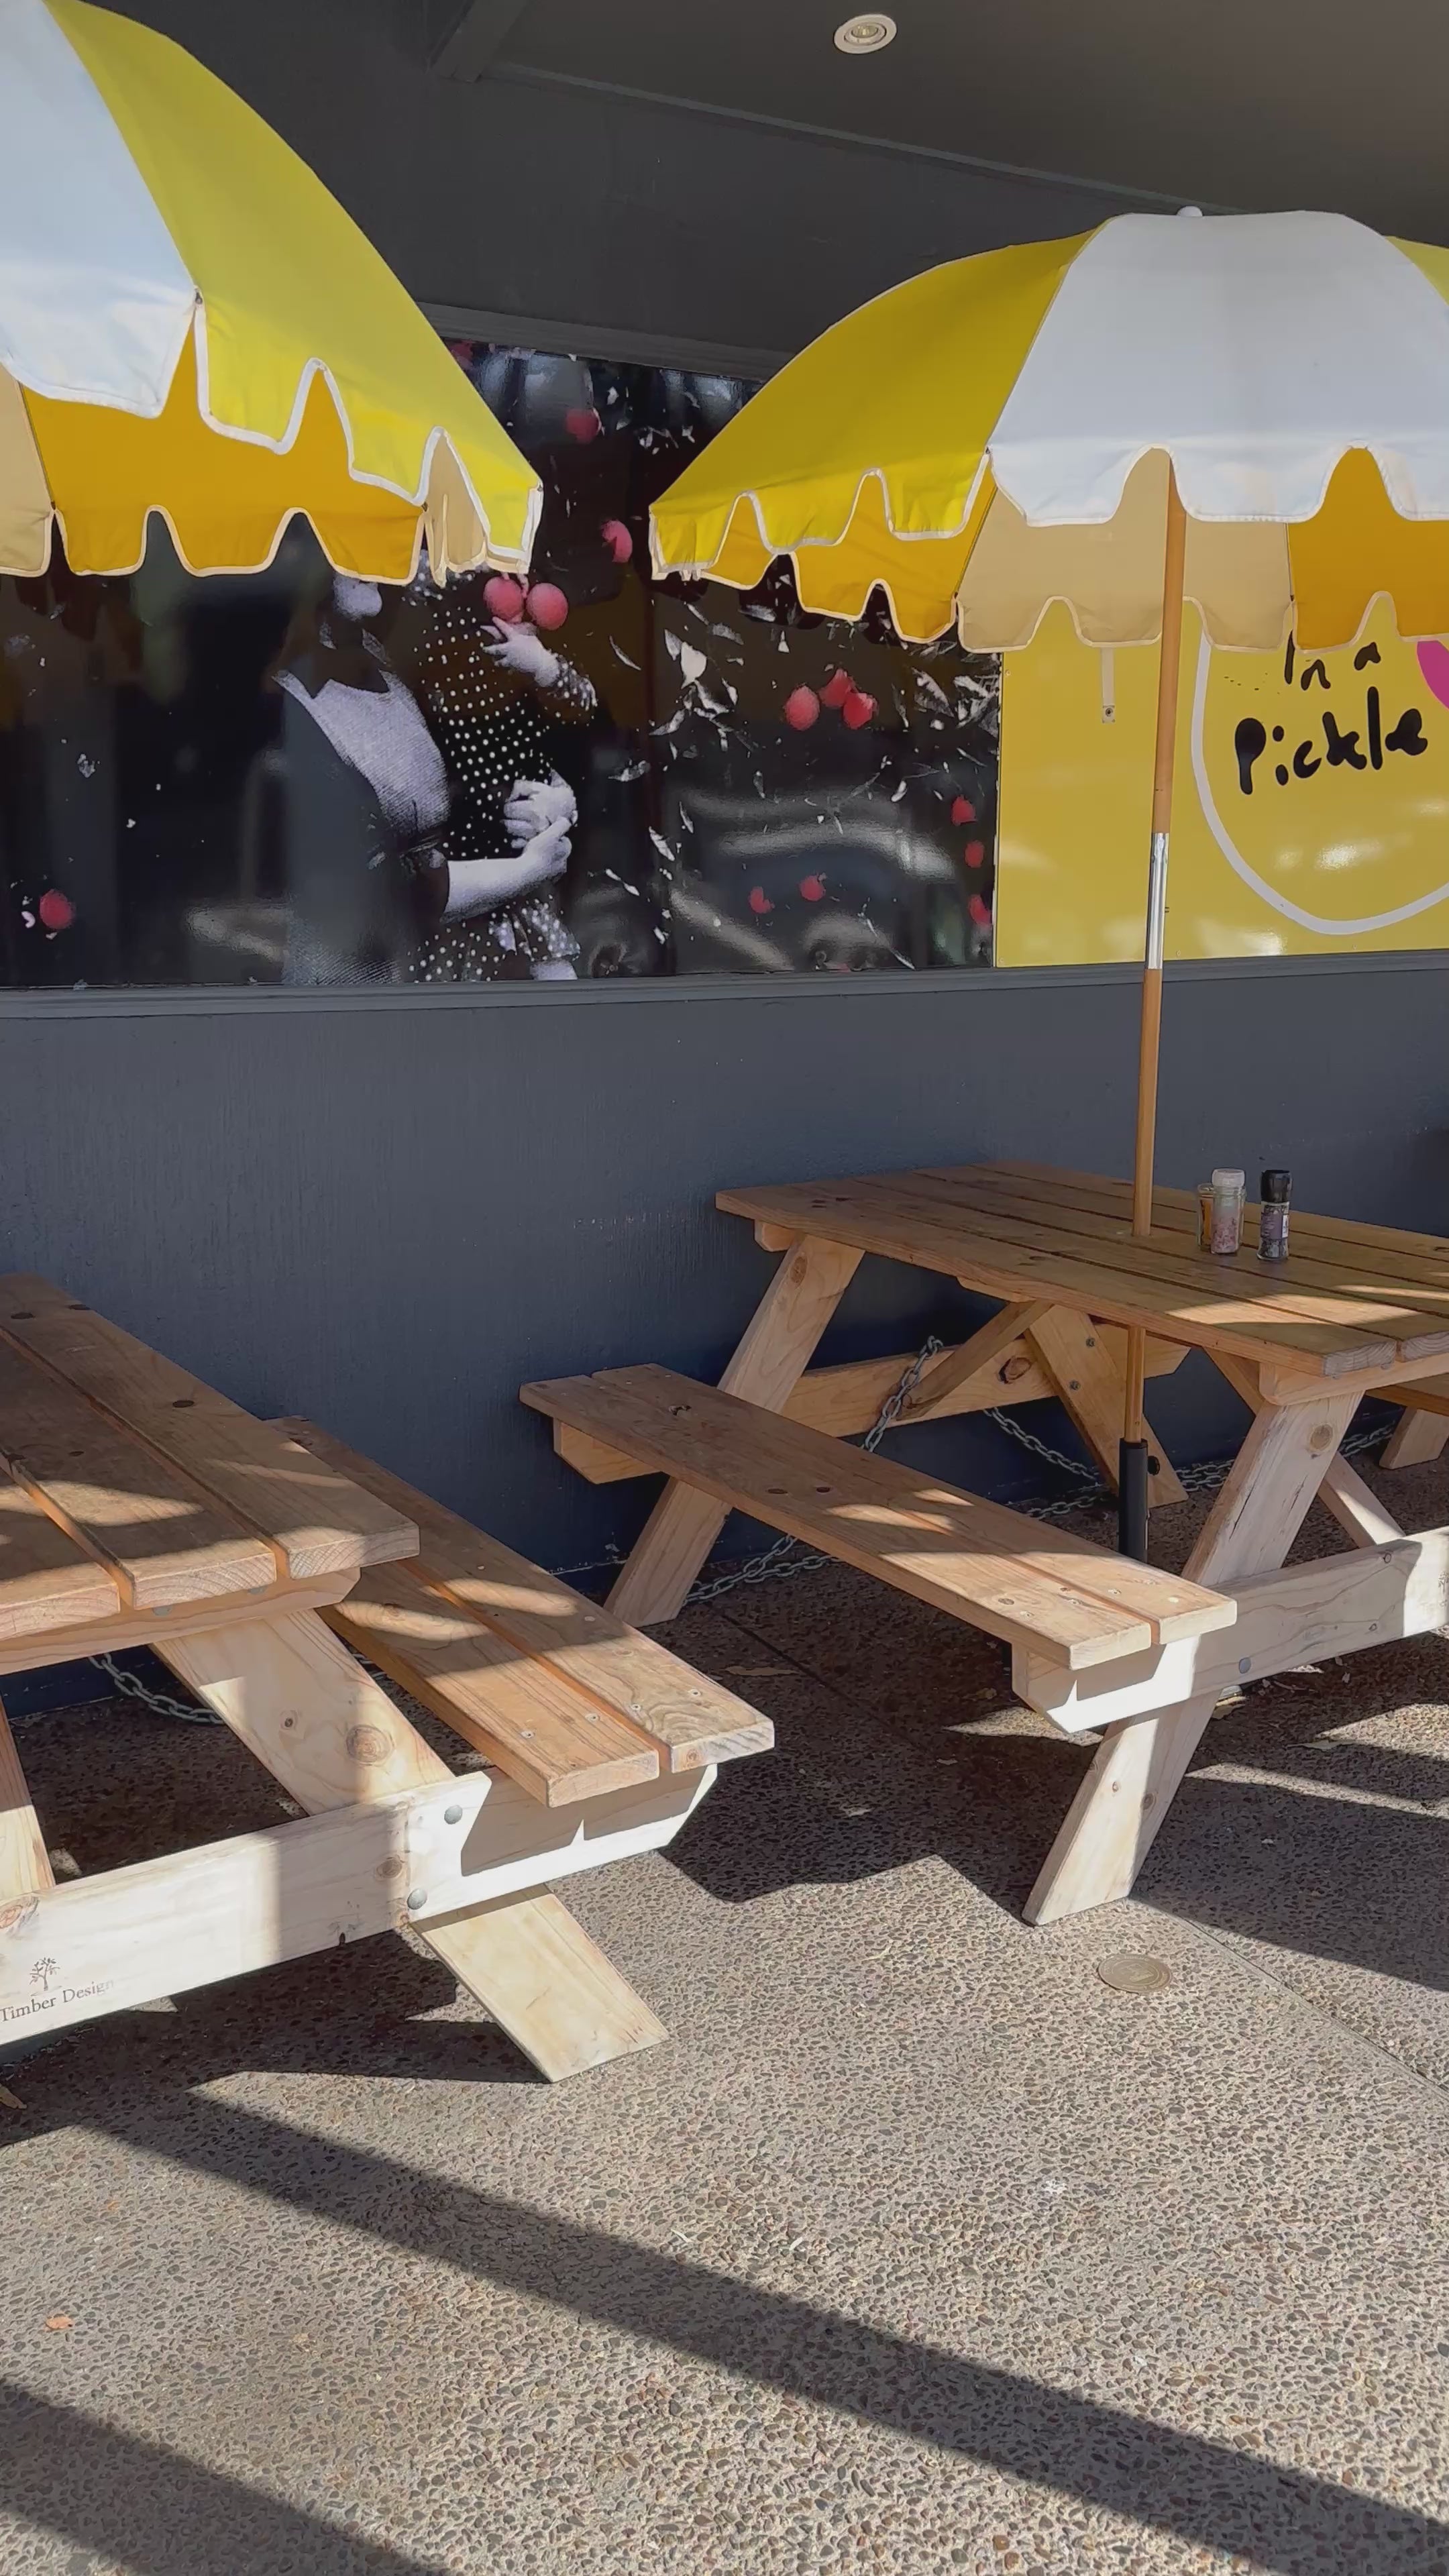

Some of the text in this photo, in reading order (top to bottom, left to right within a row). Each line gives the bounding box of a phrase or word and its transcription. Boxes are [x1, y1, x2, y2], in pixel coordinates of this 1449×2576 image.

[1284, 629, 1381, 691] In a
[1234, 686, 1428, 795] Pickle
[0, 1997, 57, 2022] Timber
